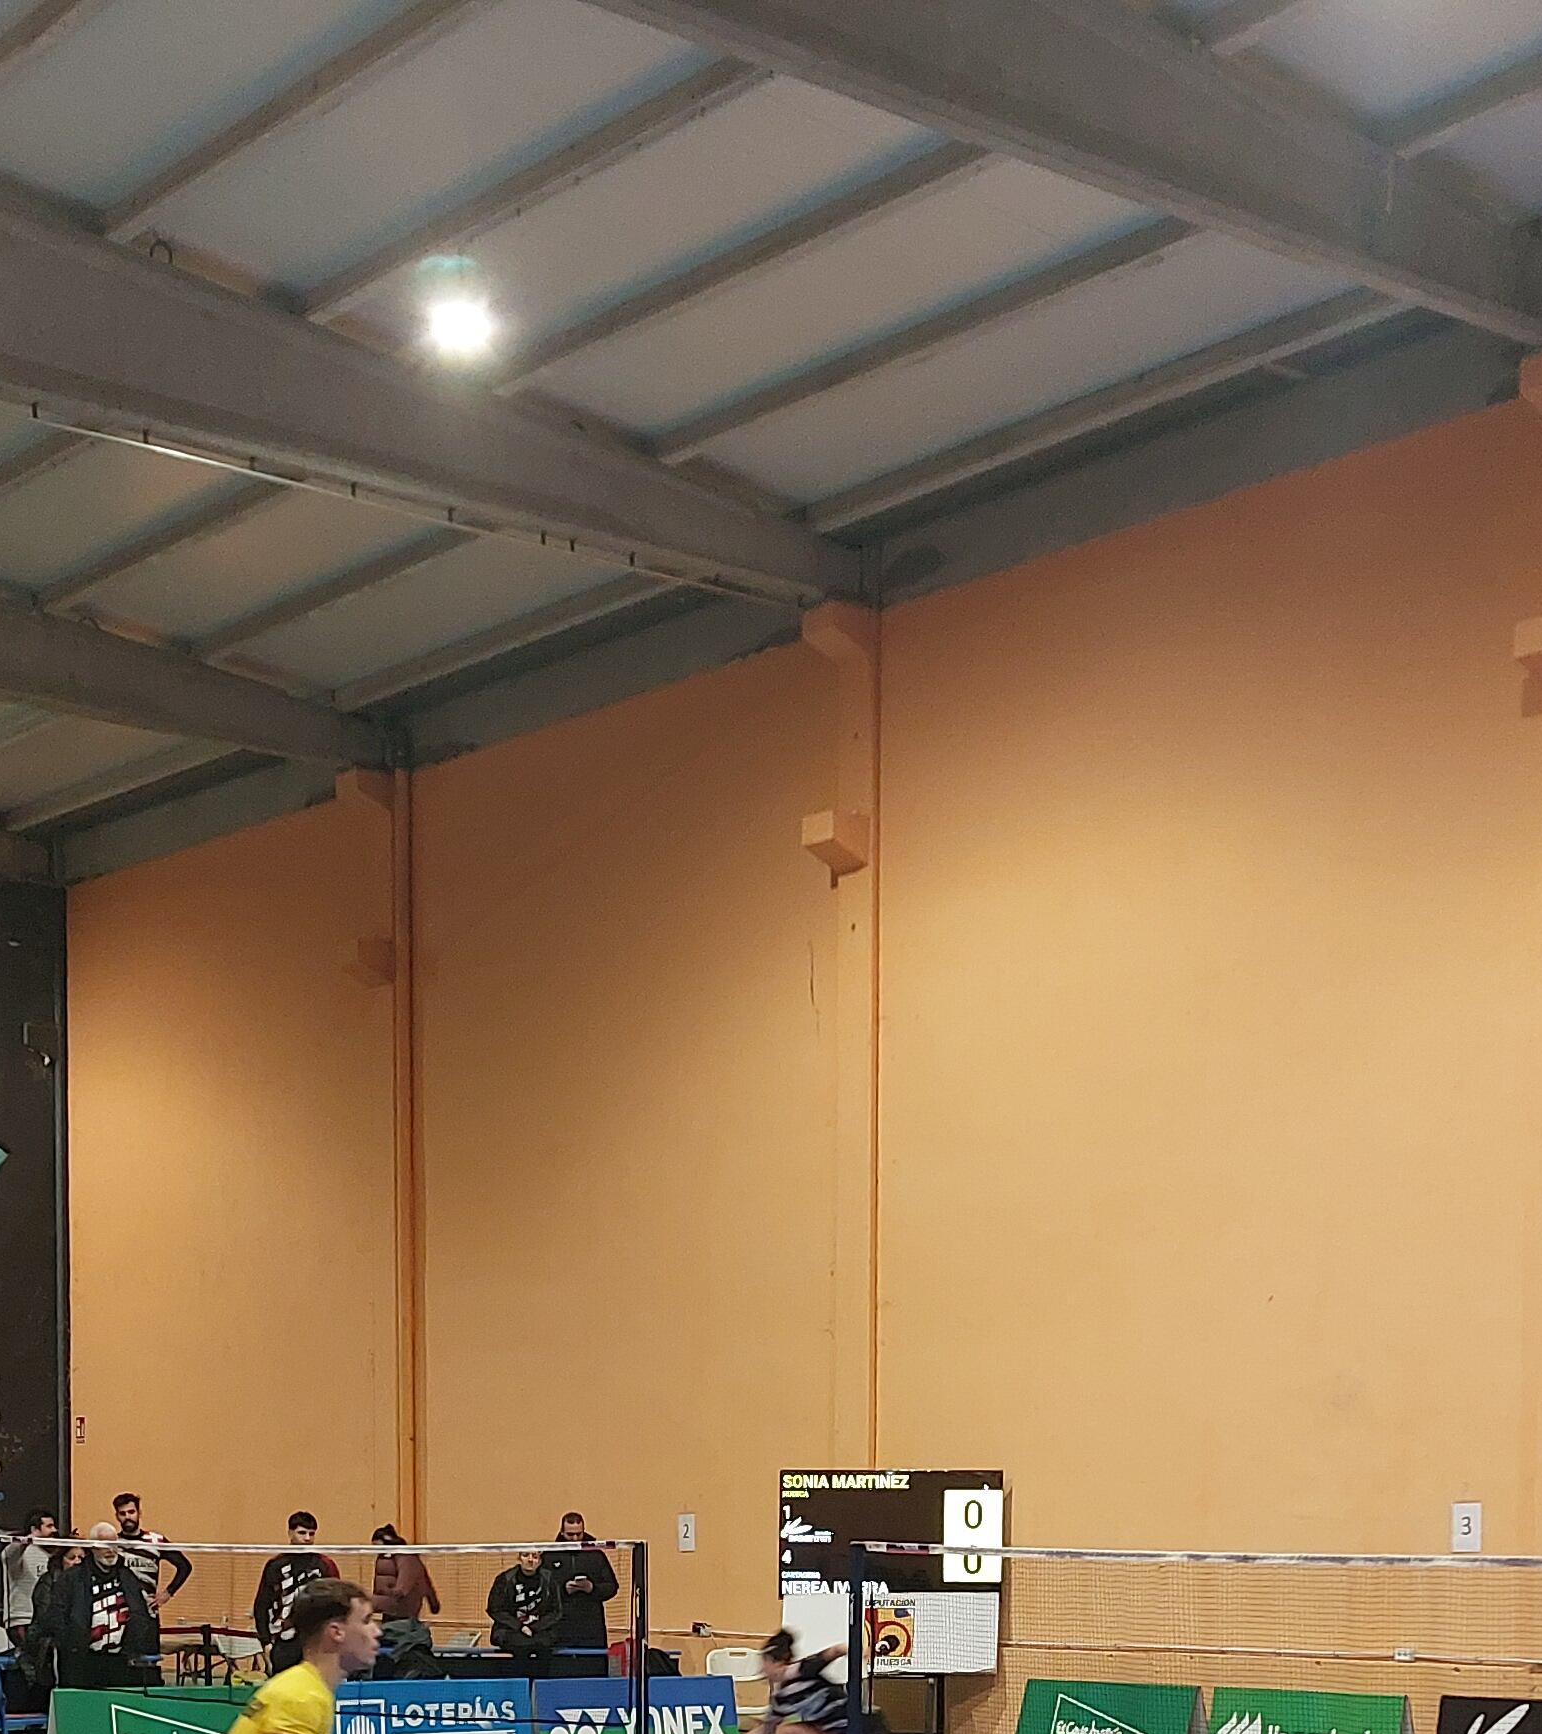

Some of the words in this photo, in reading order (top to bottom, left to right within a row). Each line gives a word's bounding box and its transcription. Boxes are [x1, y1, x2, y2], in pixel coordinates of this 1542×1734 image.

[782, 1474, 829, 1489] SONIA
[832, 1474, 910, 1489] MARTINEZ
[782, 1504, 791, 1520] 1
[964, 1499, 983, 1529] 0
[682, 1523, 690, 1539] 2
[1460, 1516, 1472, 1535] 3
[781, 1580, 831, 1595] NEREA
[391, 1696, 516, 1728] LOTERÍAS
